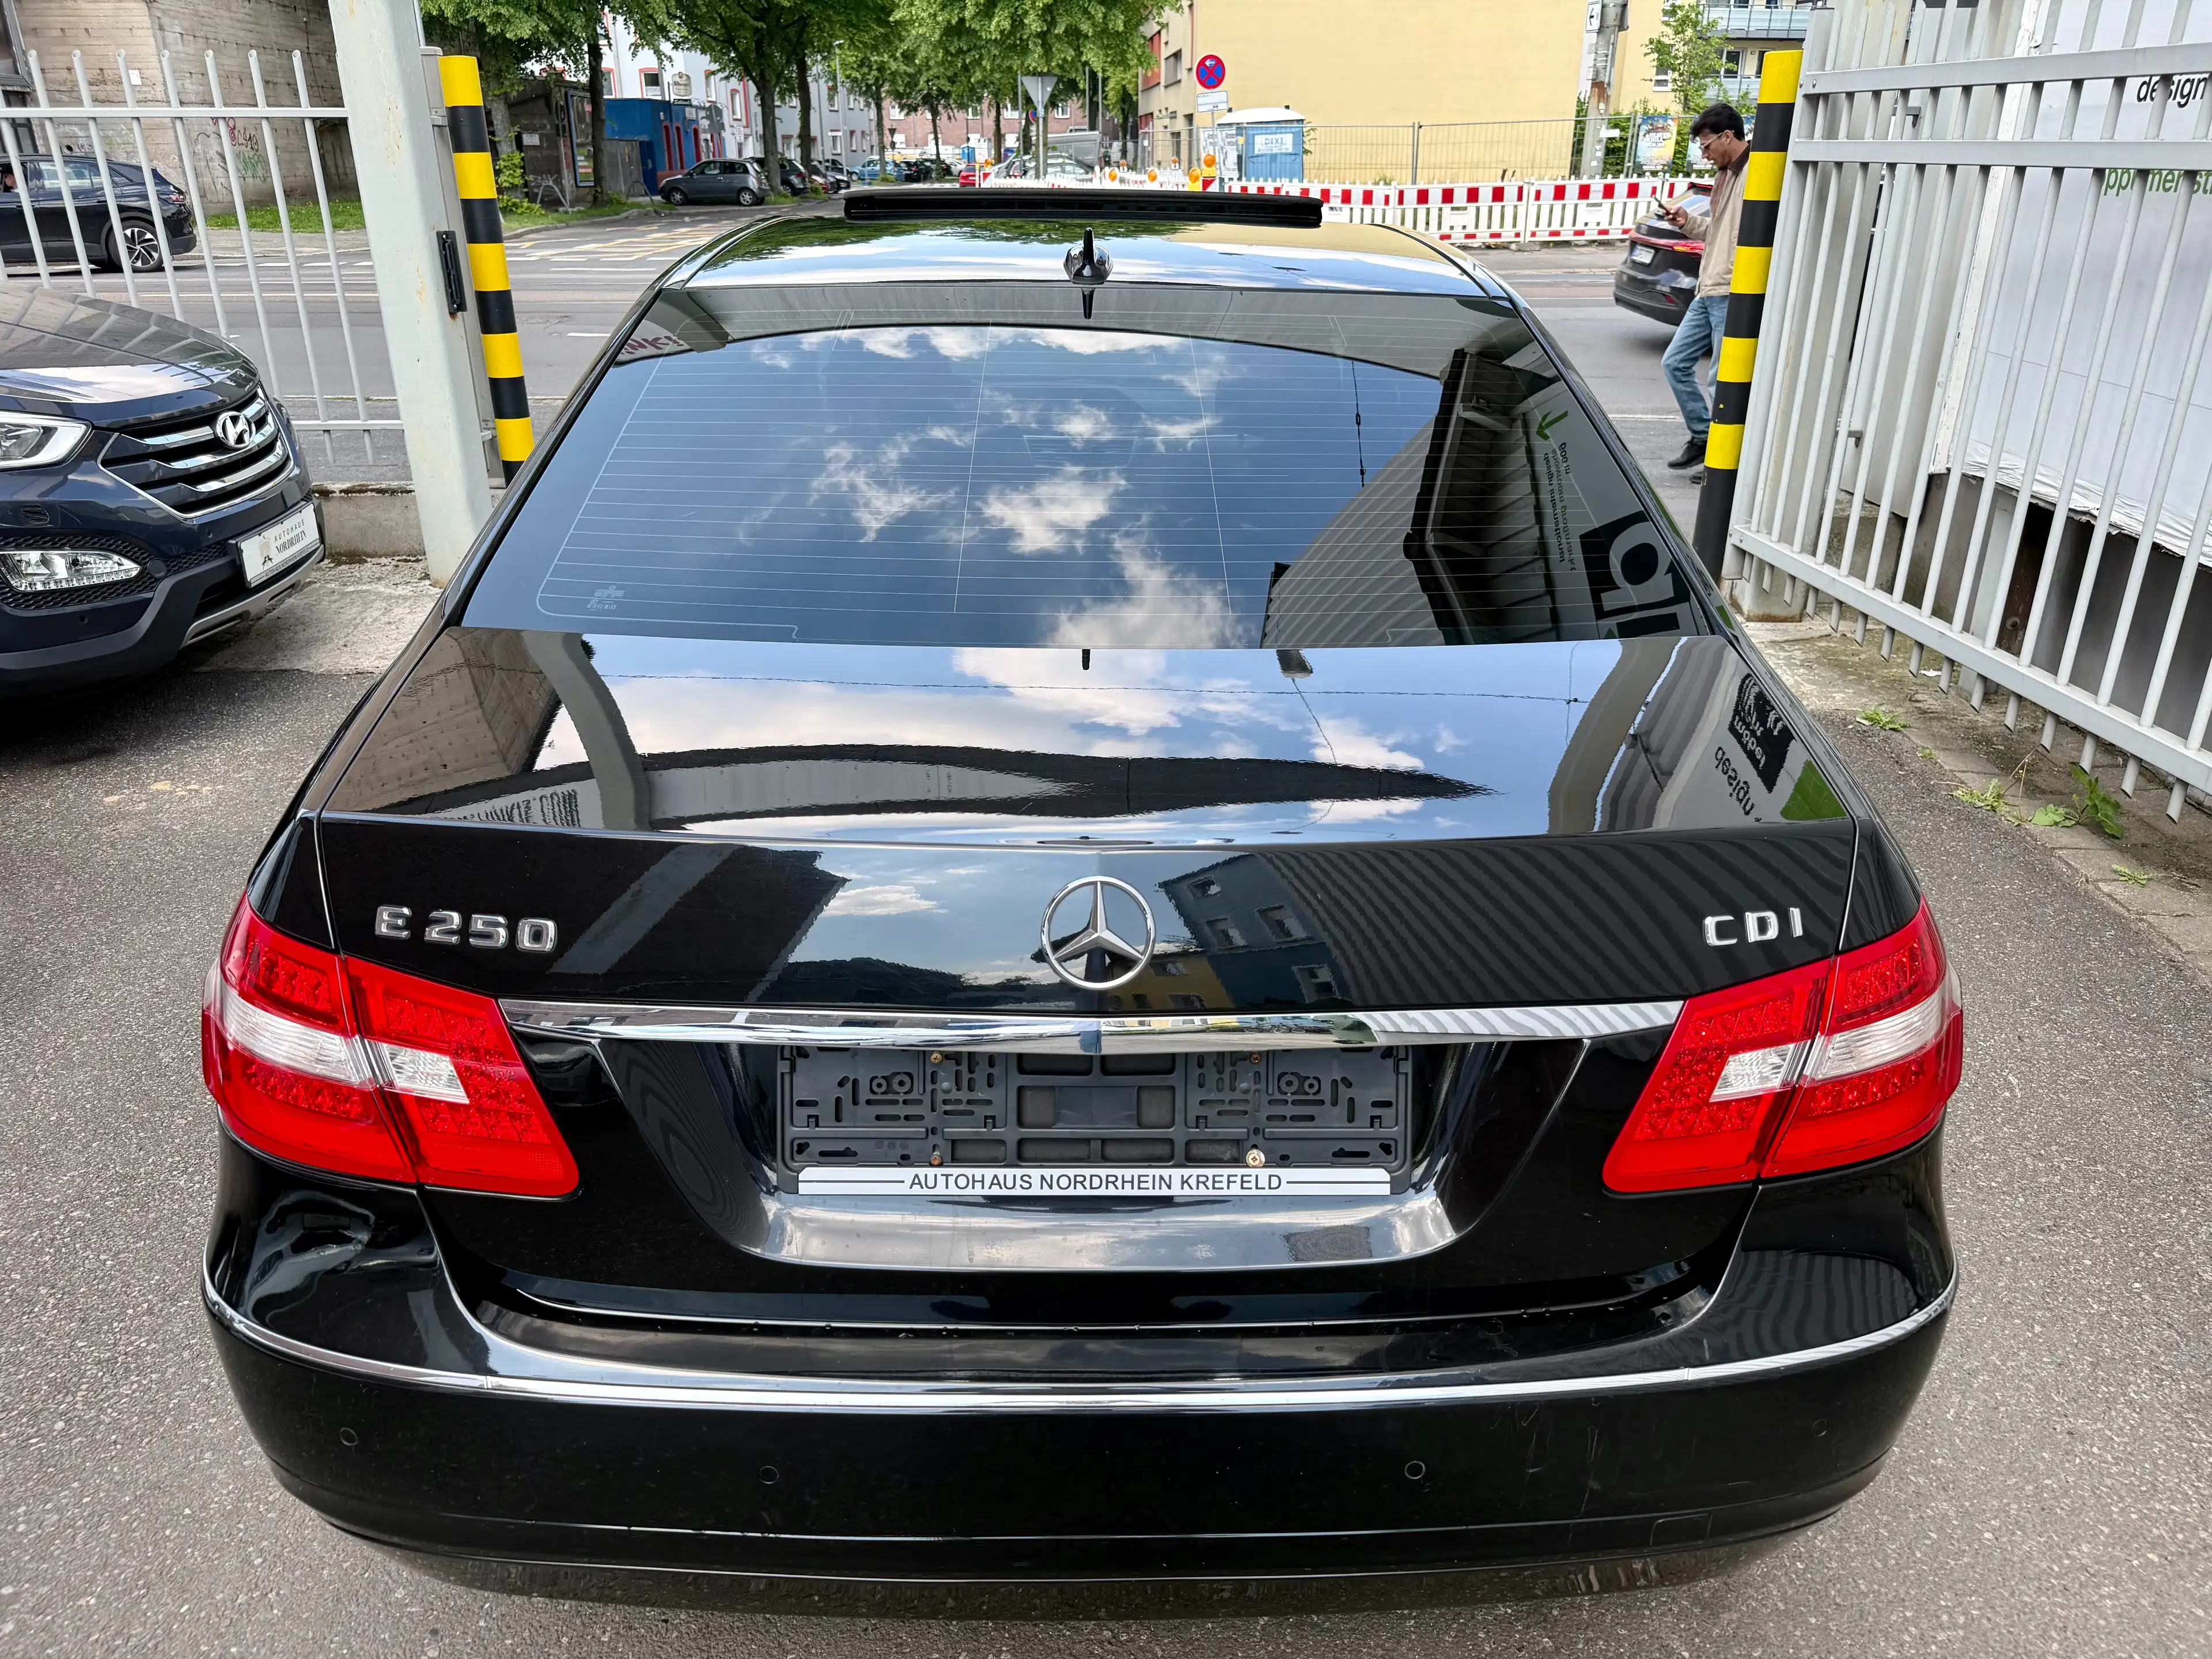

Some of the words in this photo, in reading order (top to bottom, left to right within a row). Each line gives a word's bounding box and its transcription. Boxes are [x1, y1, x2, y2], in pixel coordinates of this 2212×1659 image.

[274, 519, 305, 542] AUTOHAUS
[275, 529, 306, 556] NORDRHEIN
[375, 906, 411, 939] E
[425, 910, 557, 952] 250
[1703, 907, 1804, 946] CDI
[908, 1172, 1032, 1191] AUTOHAUS
[1039, 1172, 1173, 1191] NORDRHEIN
[1179, 1172, 1283, 1191] KREFELD
